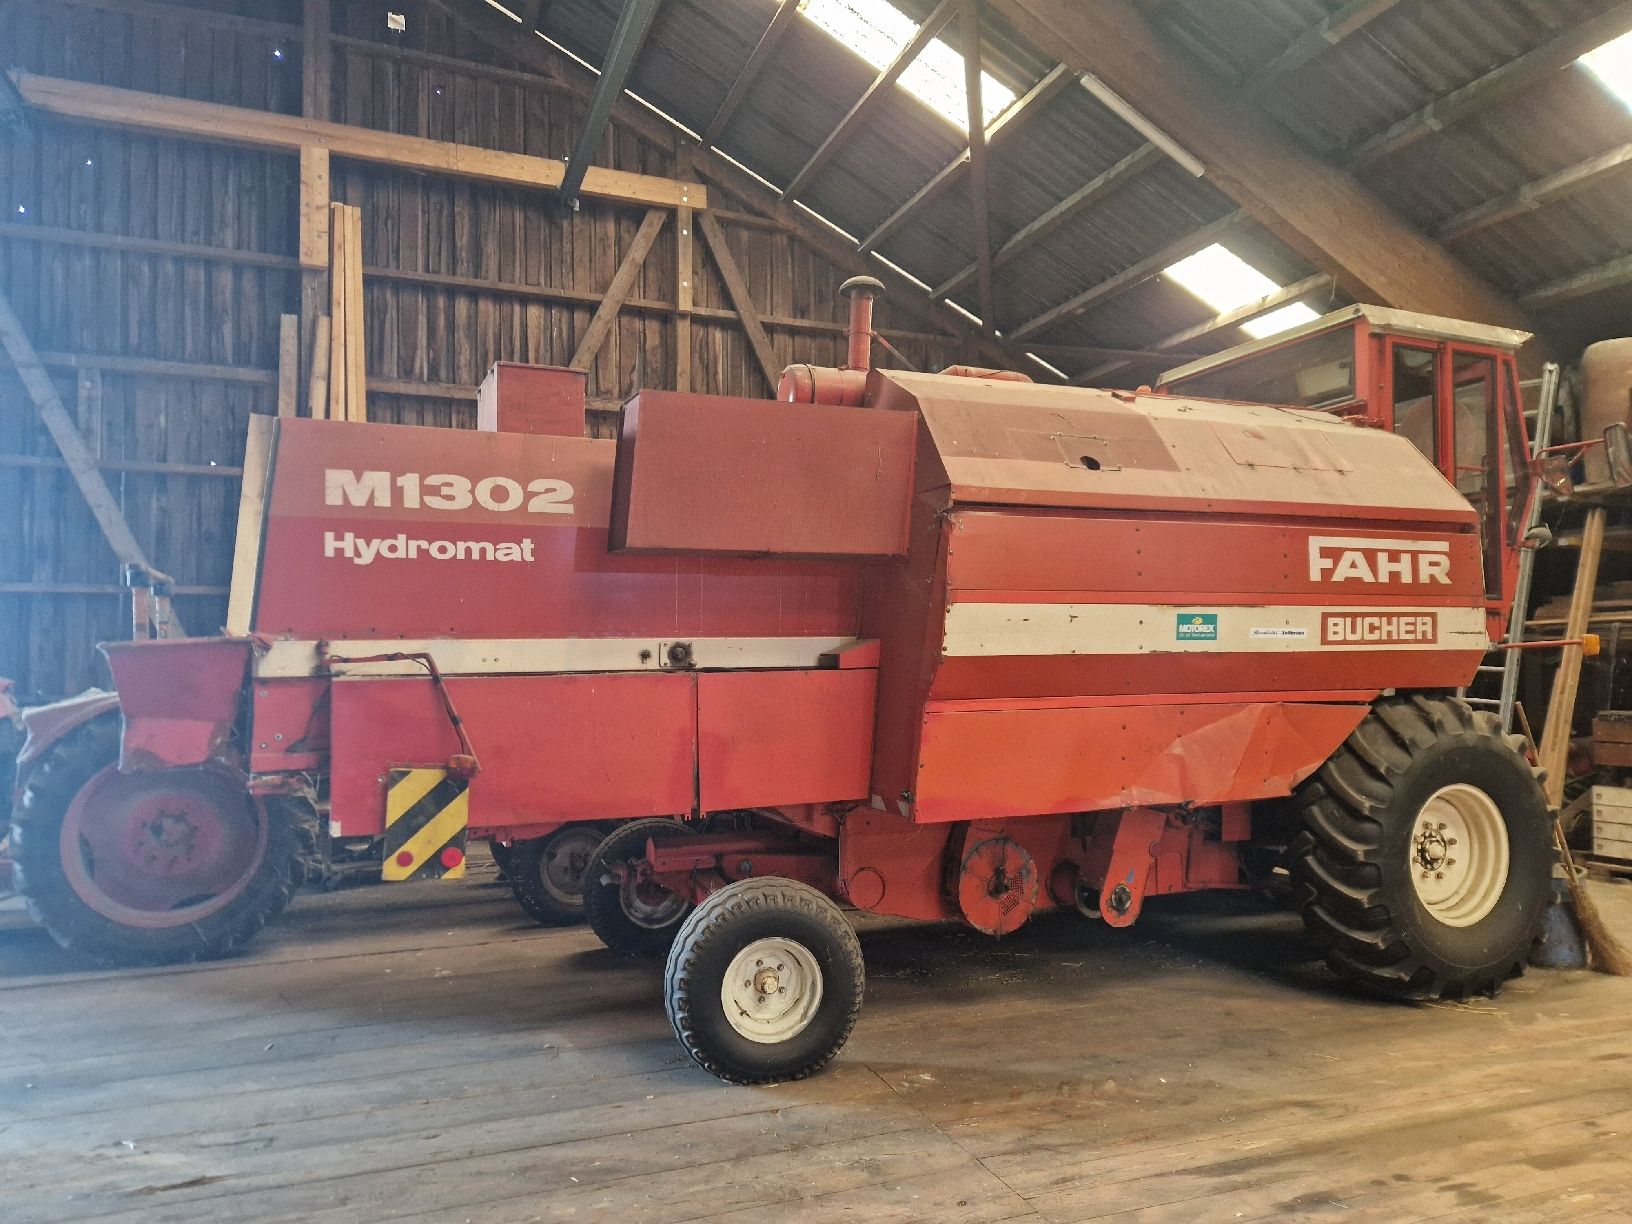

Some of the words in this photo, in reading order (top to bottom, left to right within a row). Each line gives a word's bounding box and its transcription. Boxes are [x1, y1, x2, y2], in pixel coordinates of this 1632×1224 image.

[325, 469, 574, 514] M1302
[324, 531, 535, 565] Hydromat
[1308, 535, 1453, 584] FAHR
[1178, 624, 1215, 633] MOTOREX
[1327, 616, 1433, 641] BUCHER
